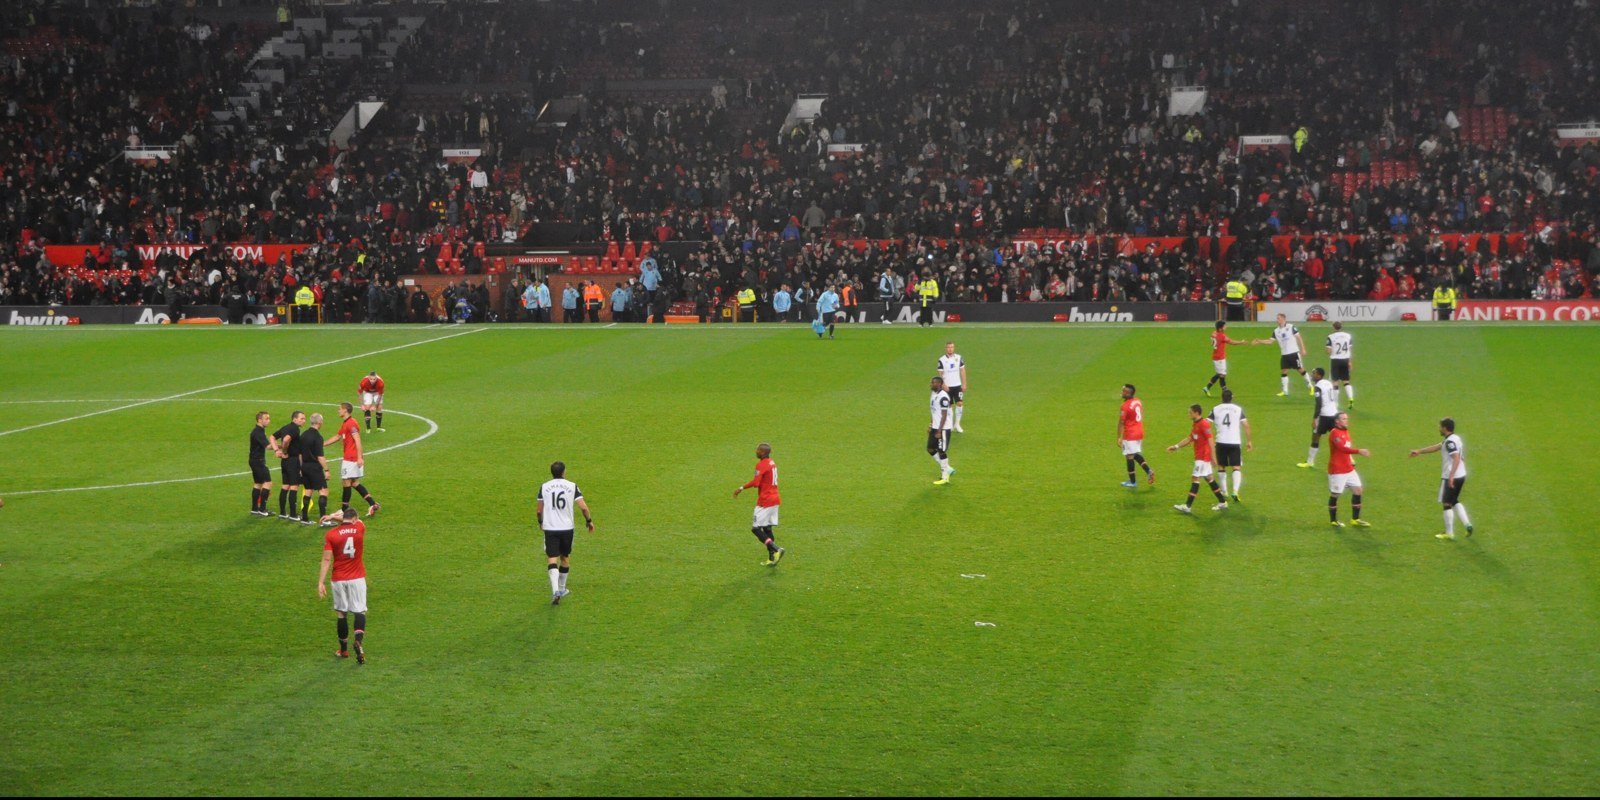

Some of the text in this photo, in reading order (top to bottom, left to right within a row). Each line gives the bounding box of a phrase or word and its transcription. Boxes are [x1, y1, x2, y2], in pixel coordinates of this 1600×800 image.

[9, 309, 69, 325] bwin
[1068, 305, 1133, 322] bwin
[1337, 305, 1377, 317] MUTV
[1336, 341, 1348, 355] 24
[1135, 406, 1142, 422] 8
[1222, 413, 1231, 427] 4
[551, 490, 566, 510] 16
[339, 528, 357, 536] JONES
[343, 536, 356, 559] 4
